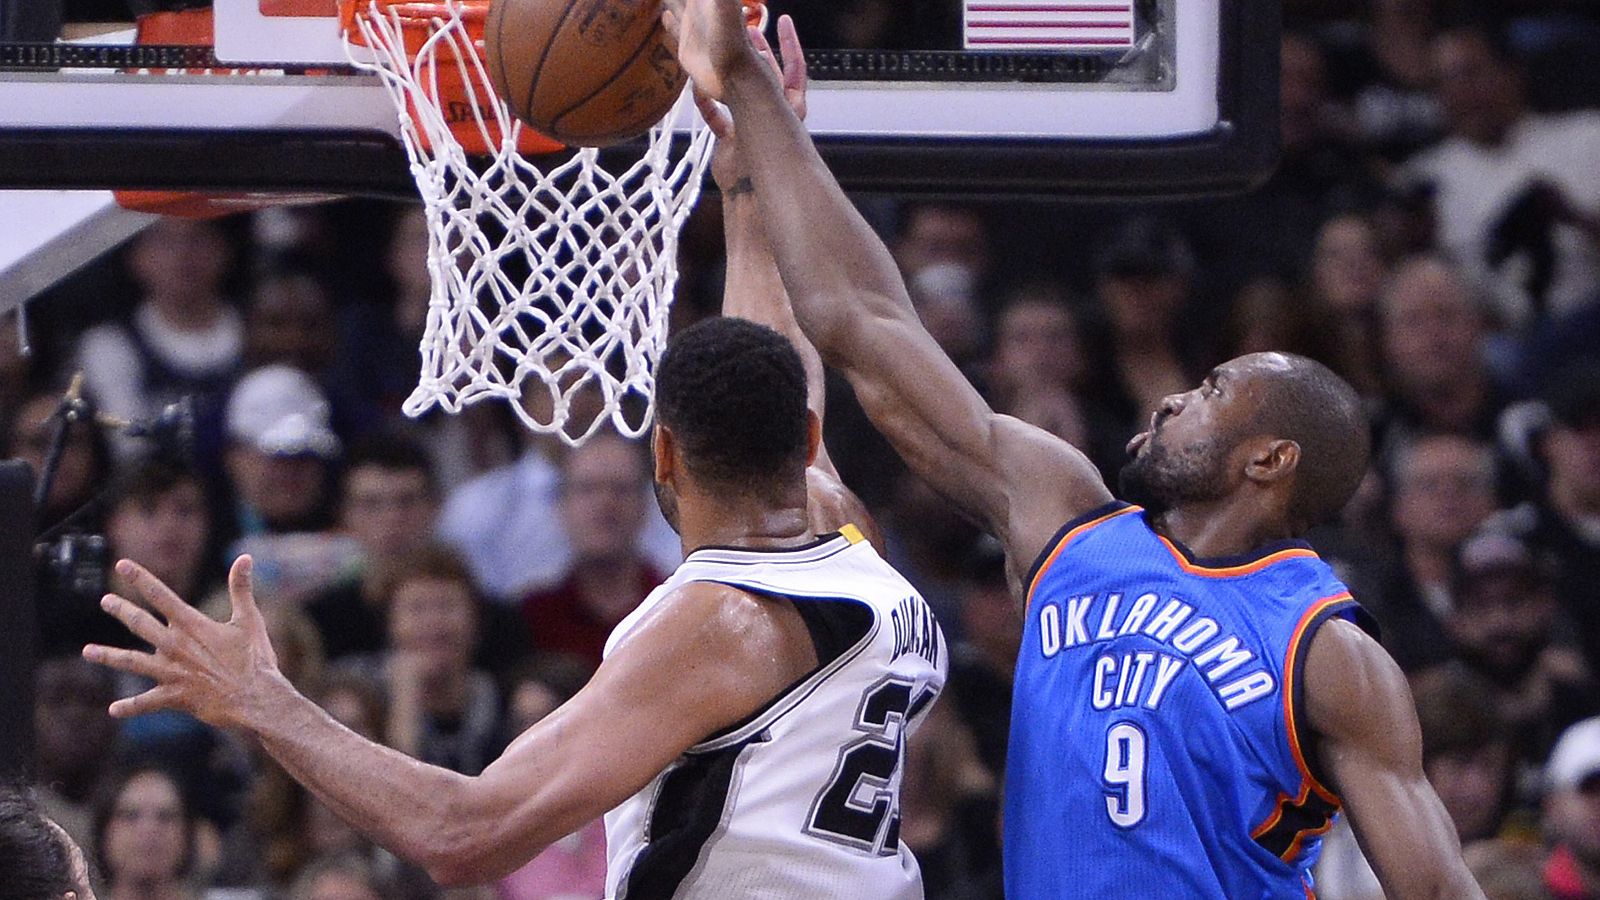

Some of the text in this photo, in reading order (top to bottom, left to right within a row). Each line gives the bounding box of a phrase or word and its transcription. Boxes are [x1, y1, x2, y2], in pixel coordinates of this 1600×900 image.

[1040, 593, 1275, 710] OKLAHOMA
[1091, 651, 1183, 710] CITY
[1104, 722, 1147, 828] 9
